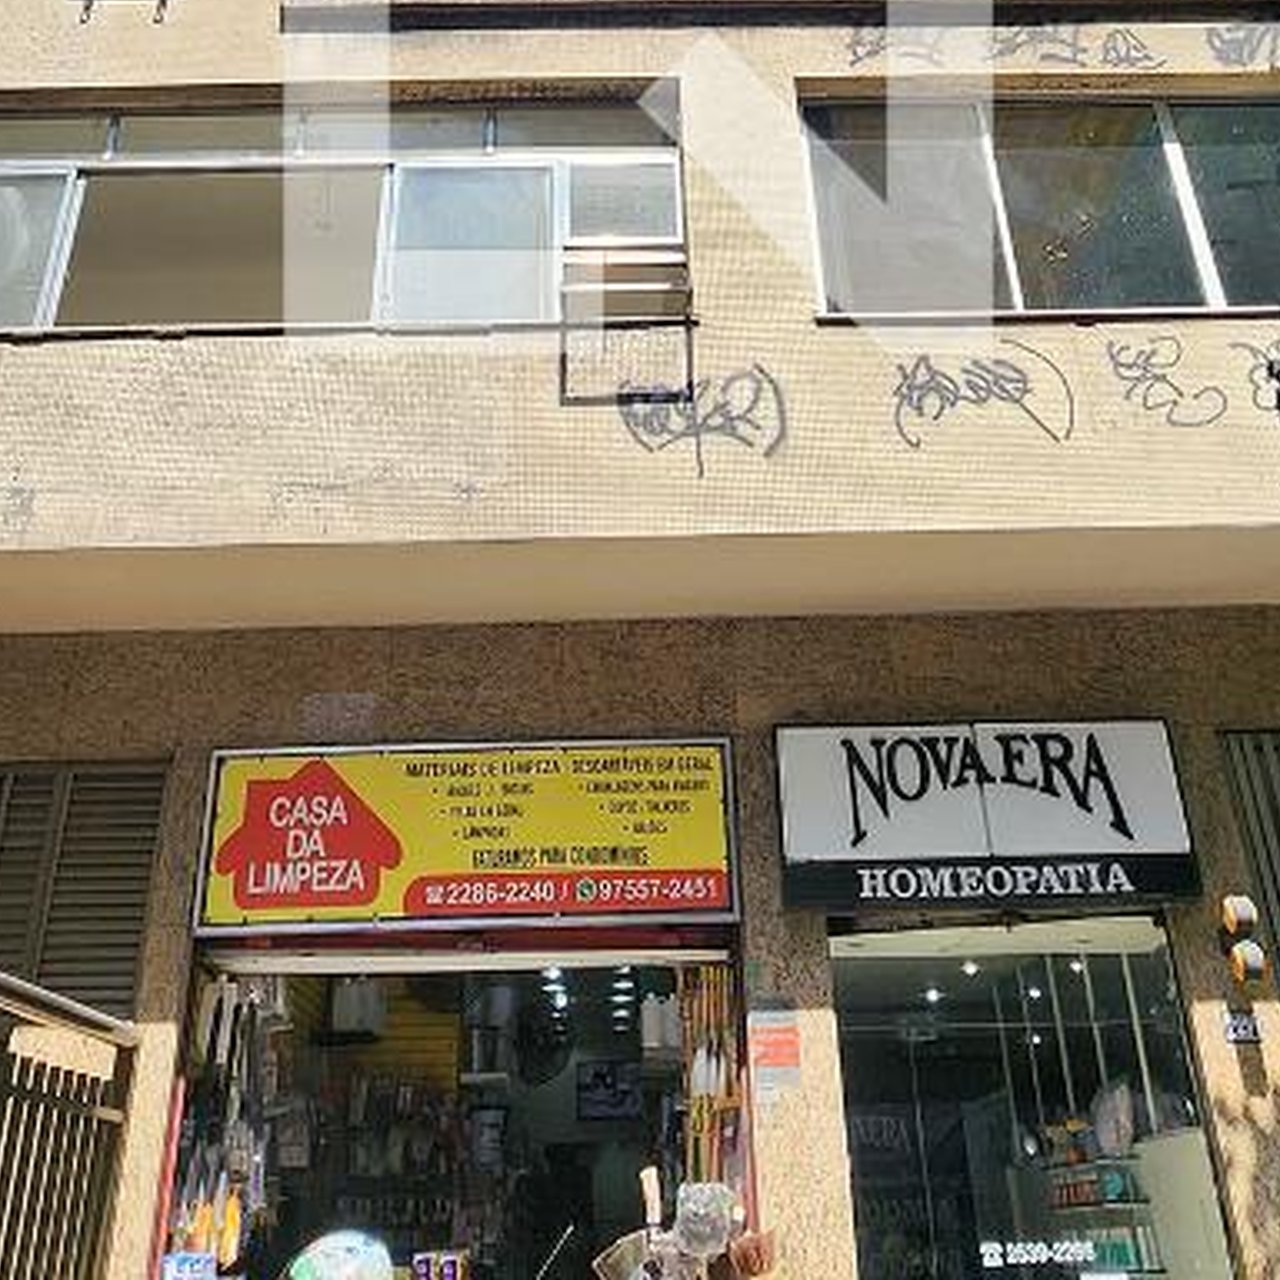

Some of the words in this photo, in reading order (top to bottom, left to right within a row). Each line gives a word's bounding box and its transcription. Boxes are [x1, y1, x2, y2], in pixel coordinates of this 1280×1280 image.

[269, 796, 348, 827] CASA
[286, 829, 325, 858] DA
[246, 859, 365, 895] LIMPEZA
[447, 881, 555, 904] 2286-2240
[857, 863, 1135, 899] HOMEOPATIA
